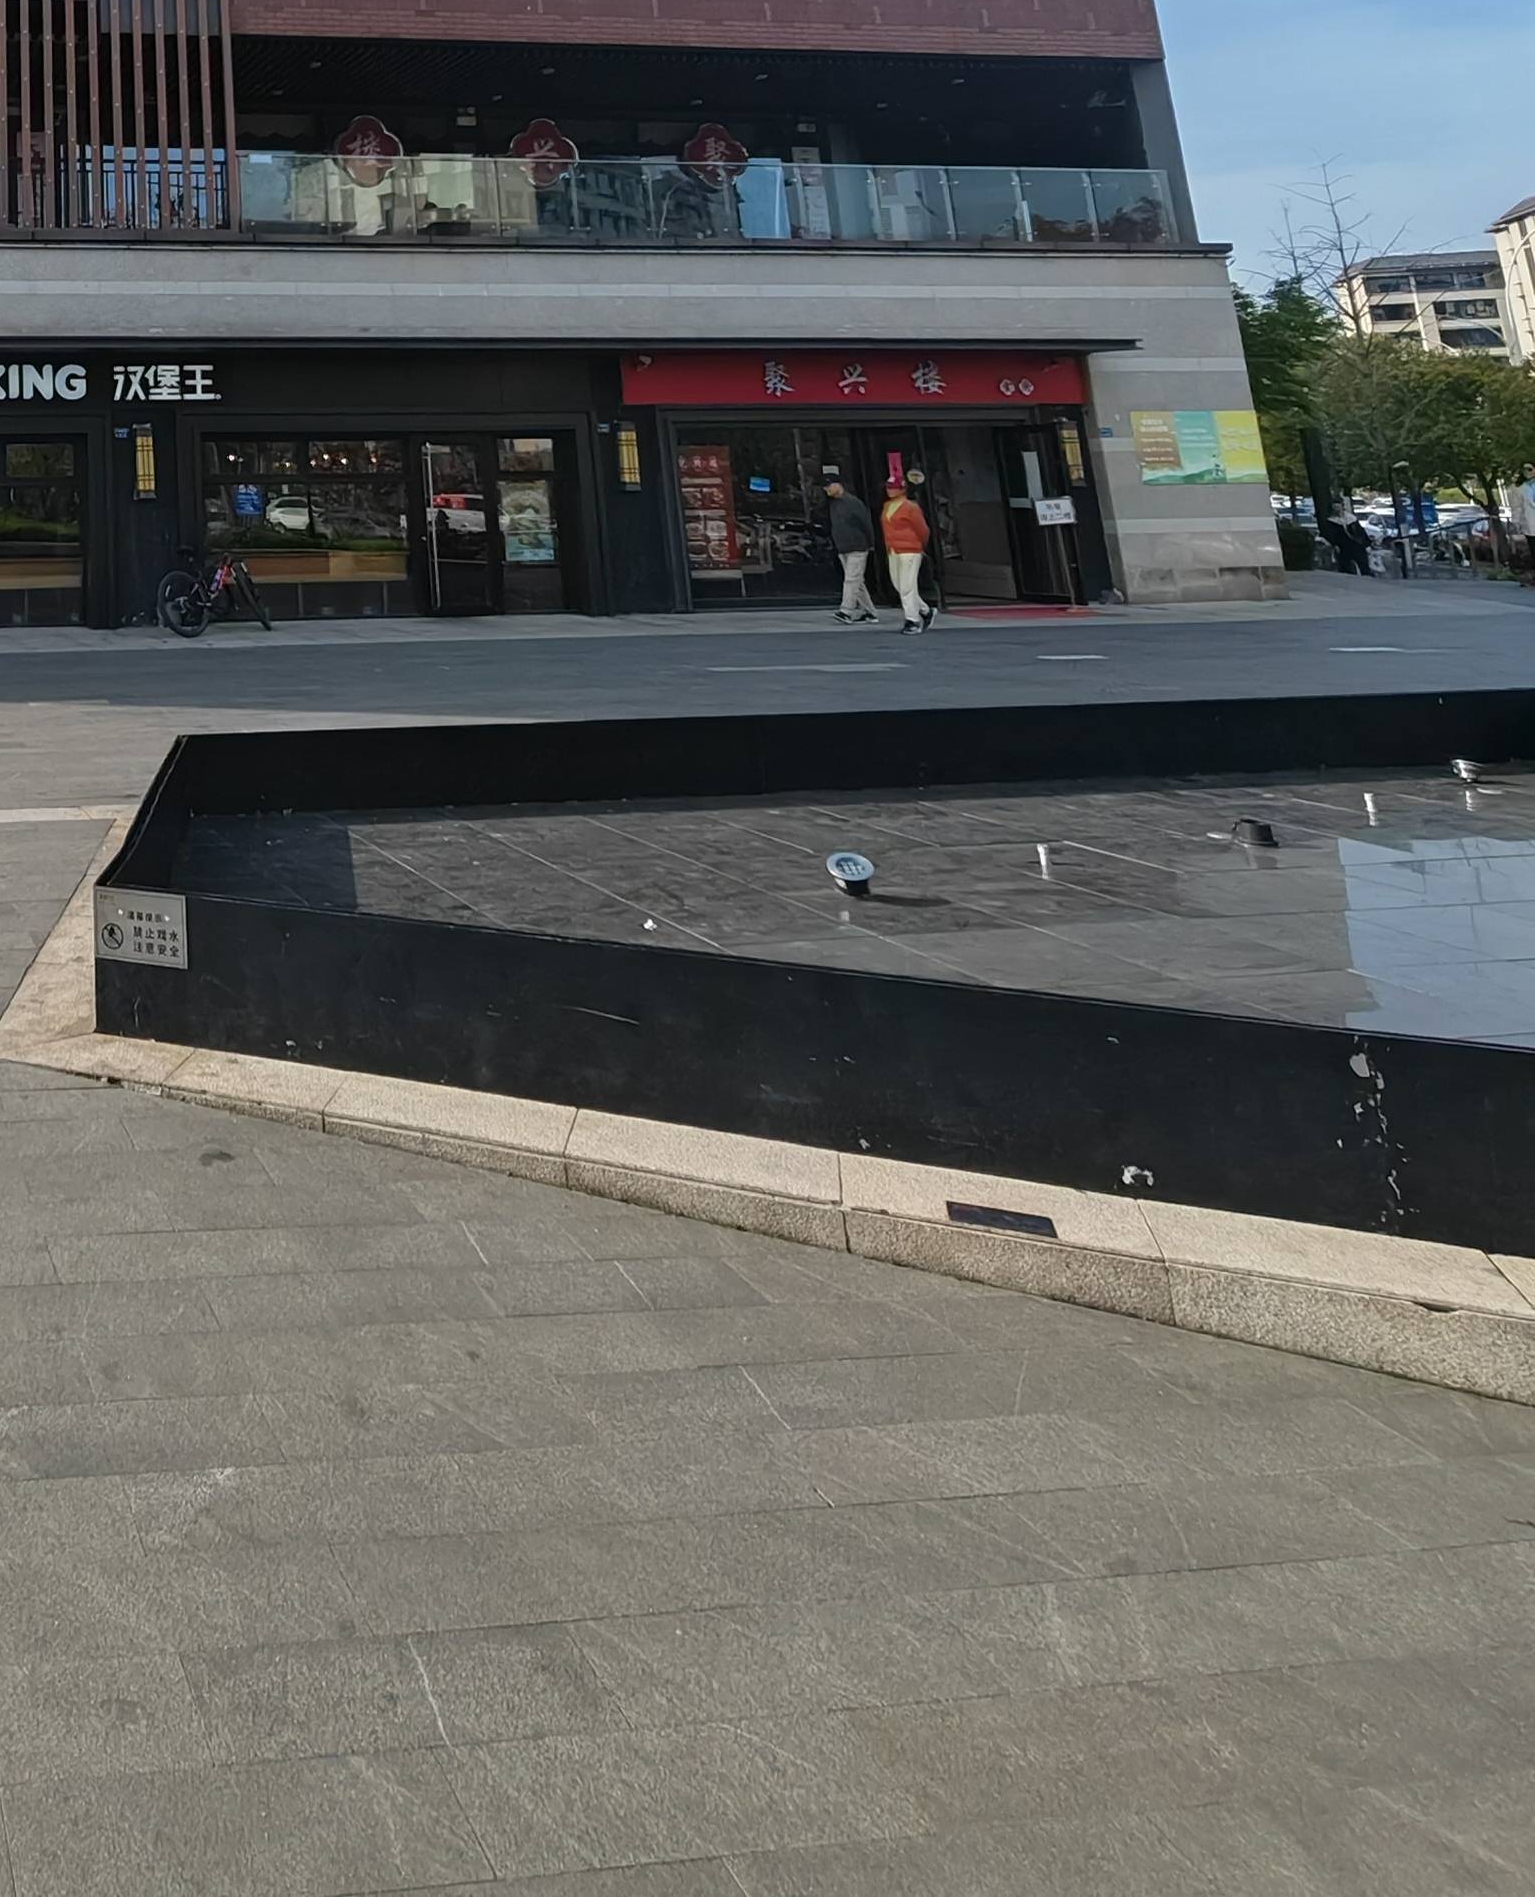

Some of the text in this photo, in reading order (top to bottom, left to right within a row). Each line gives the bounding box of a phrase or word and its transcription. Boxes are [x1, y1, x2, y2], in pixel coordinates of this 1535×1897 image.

[113, 364, 217, 401] 汉堡王
[763, 360, 947, 397] 聚兴楼
[133, 940, 179, 958] 注意安全
